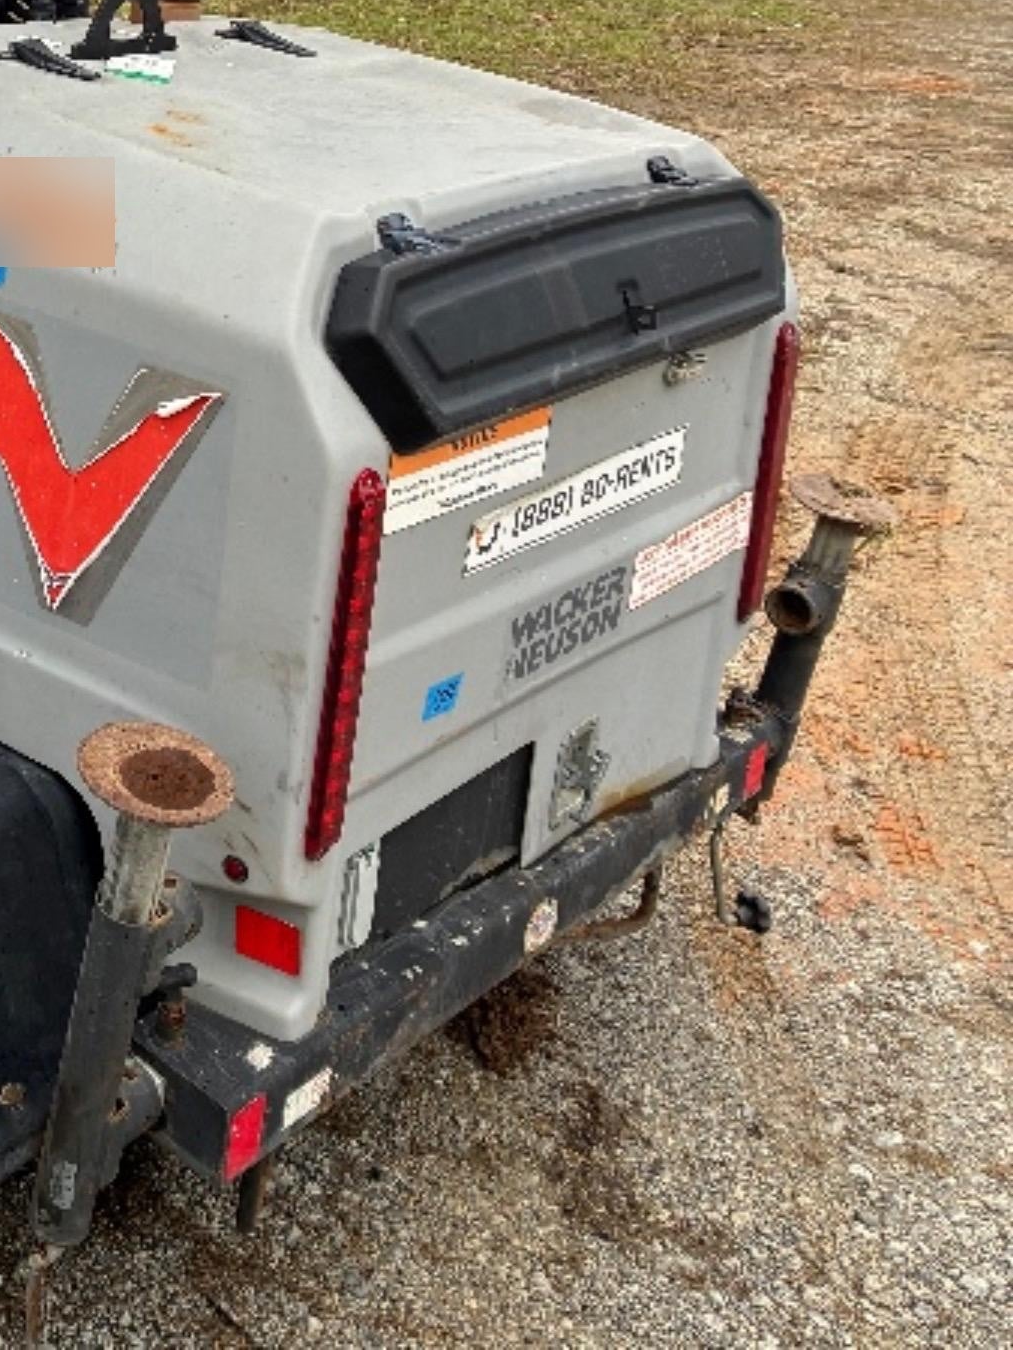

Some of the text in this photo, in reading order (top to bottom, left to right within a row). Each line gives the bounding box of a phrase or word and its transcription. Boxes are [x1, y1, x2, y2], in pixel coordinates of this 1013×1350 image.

[512, 485, 574, 537] (888)
[505, 597, 624, 679] NEUSON
[511, 566, 627, 648] WACKER
